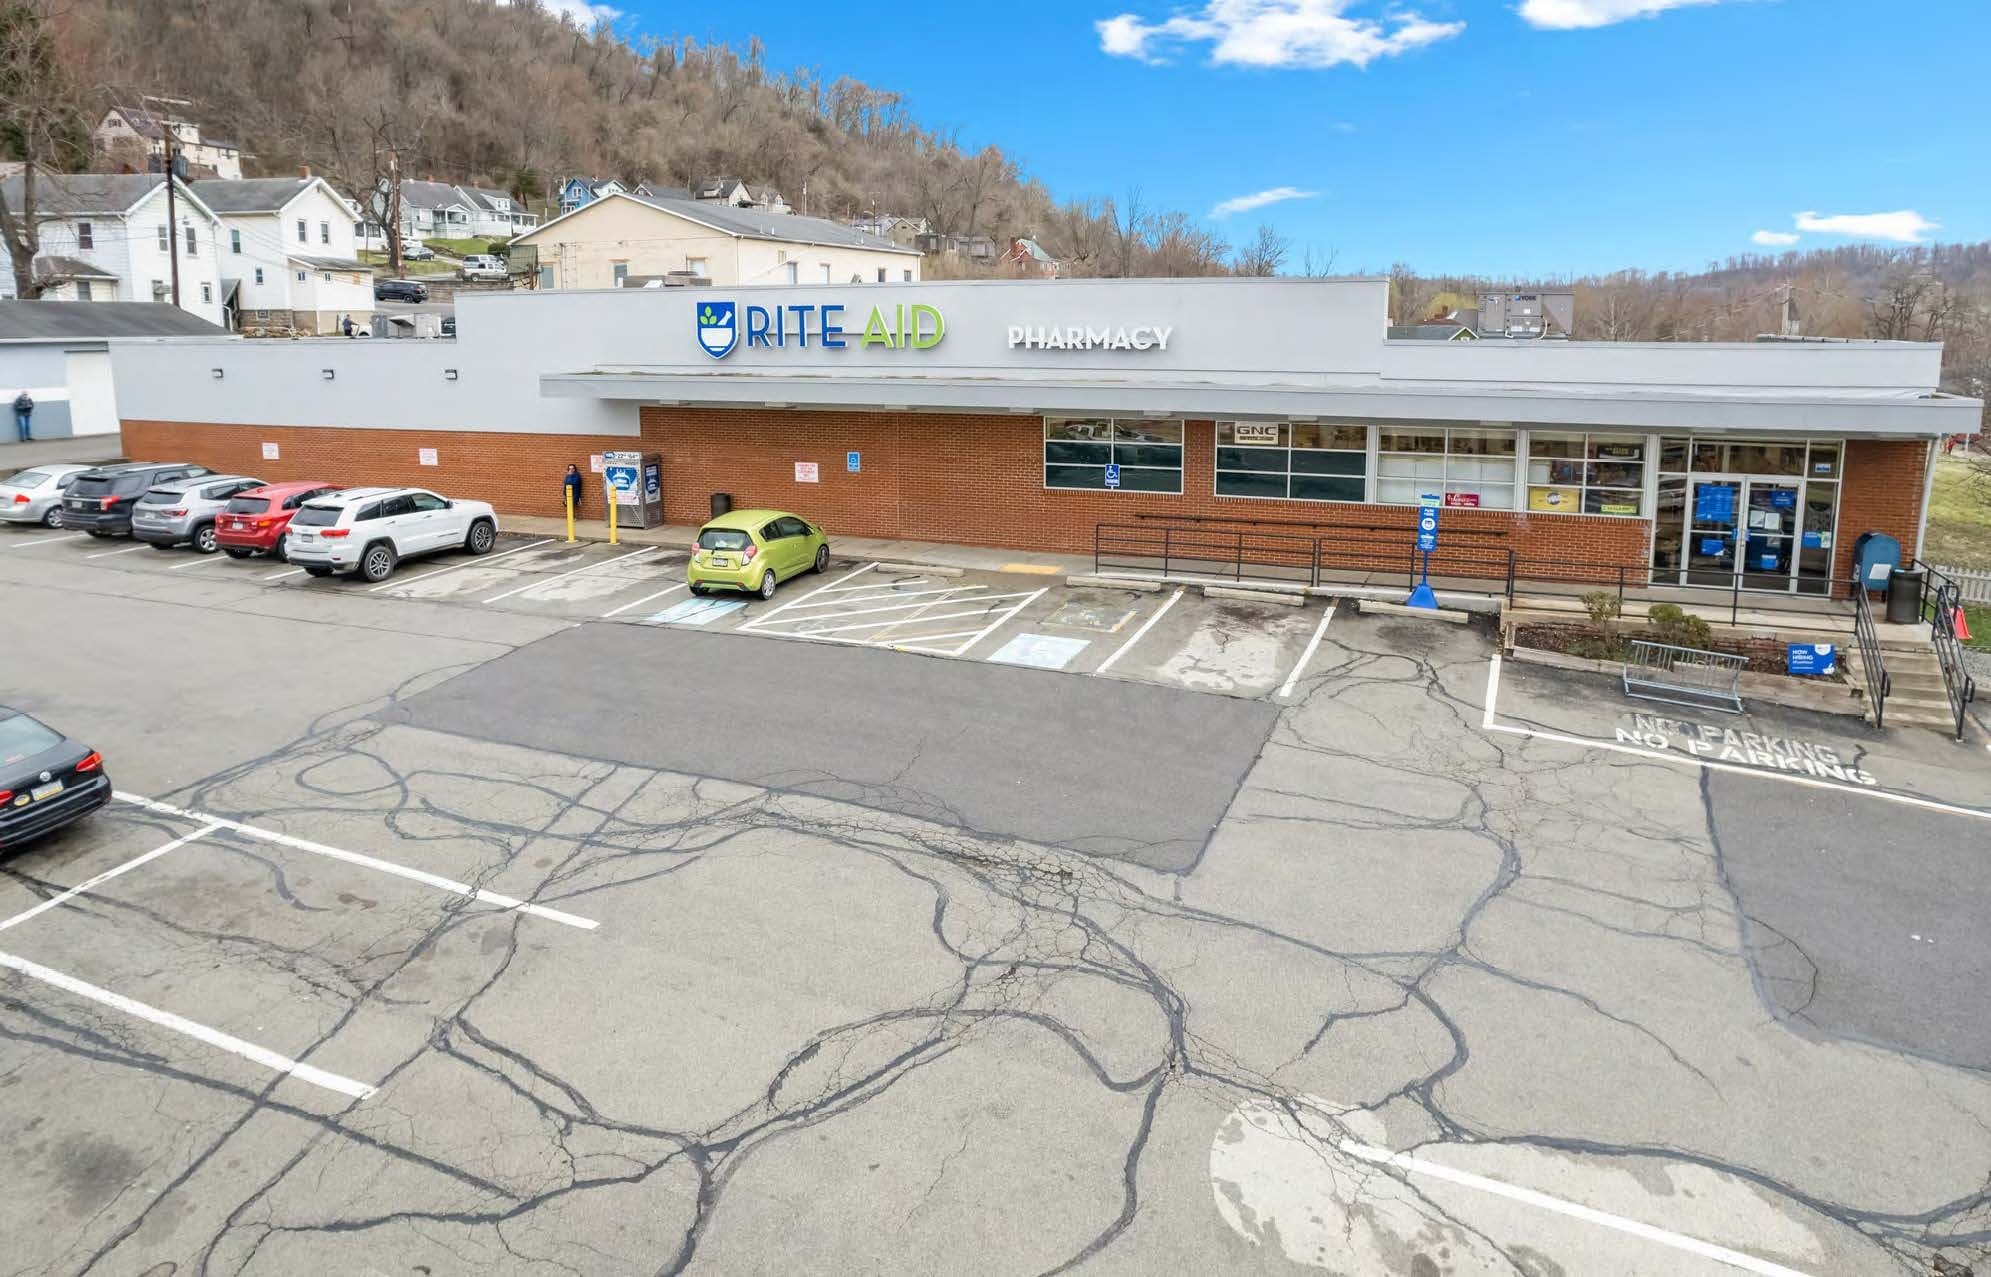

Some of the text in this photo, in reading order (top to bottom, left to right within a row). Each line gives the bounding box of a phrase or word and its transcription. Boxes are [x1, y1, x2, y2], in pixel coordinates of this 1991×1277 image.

[746, 303, 945, 350] RITE AID
[1008, 324, 1173, 350] PHARMACY
[1237, 425, 1277, 436] GNC
[1615, 727, 1669, 750] NO
[1698, 724, 1840, 765] PARKING
